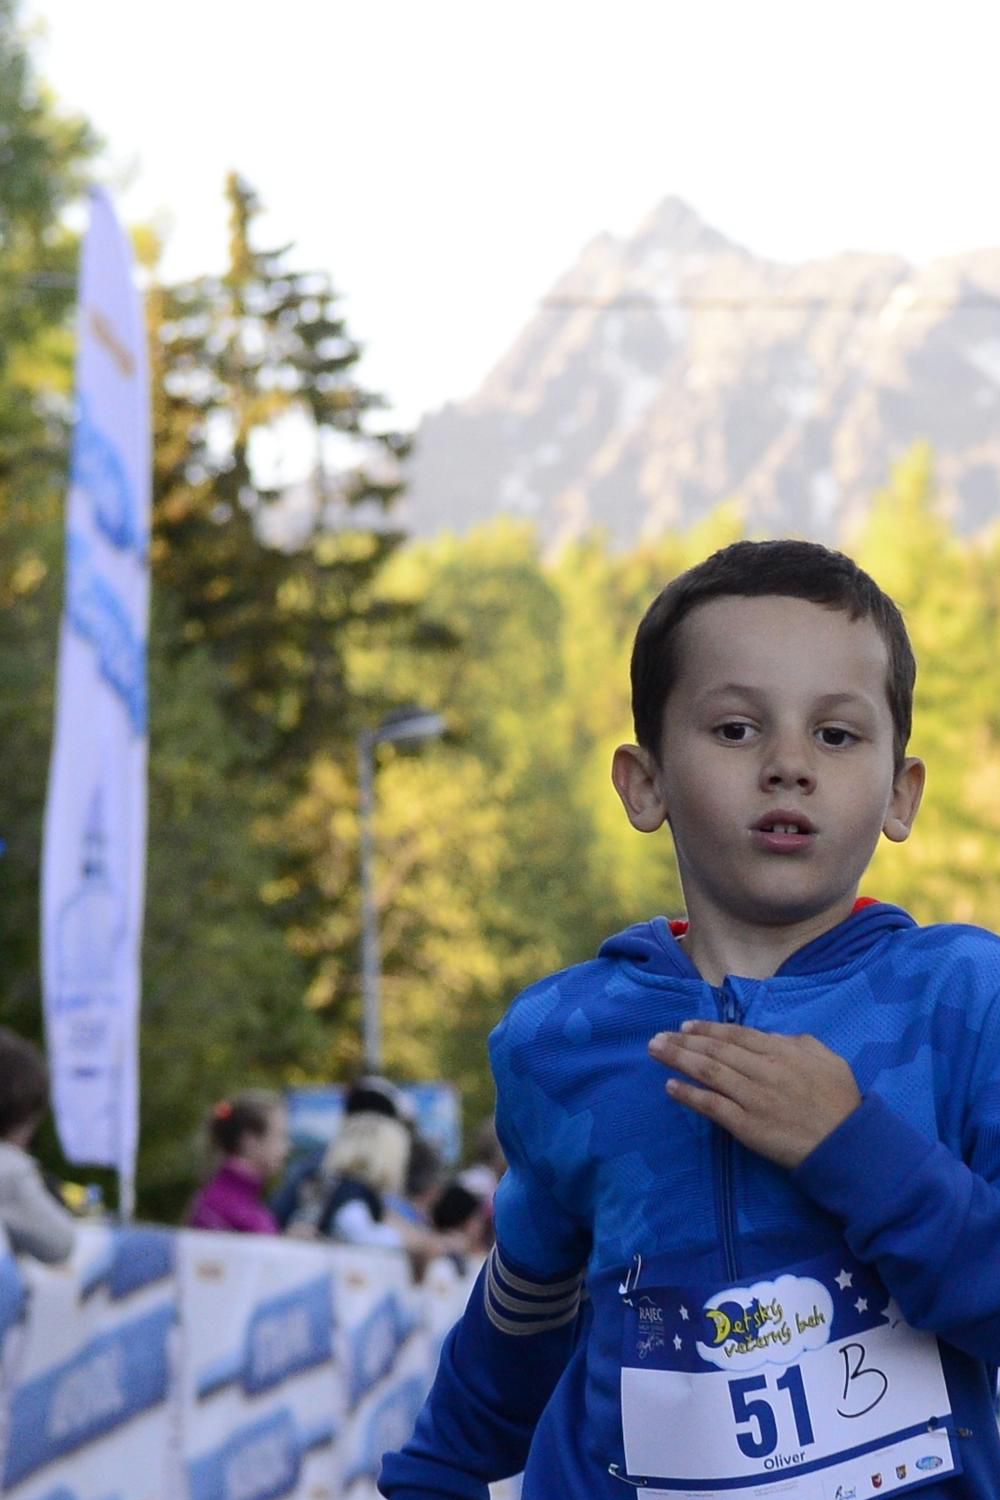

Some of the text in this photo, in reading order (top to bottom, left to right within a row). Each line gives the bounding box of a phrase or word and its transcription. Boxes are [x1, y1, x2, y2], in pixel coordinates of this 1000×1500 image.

[795, 1305, 827, 1334] beh
[837, 1343, 888, 1418] B
[728, 1364, 815, 1458] 51
[763, 1452, 806, 1470] Oliver
